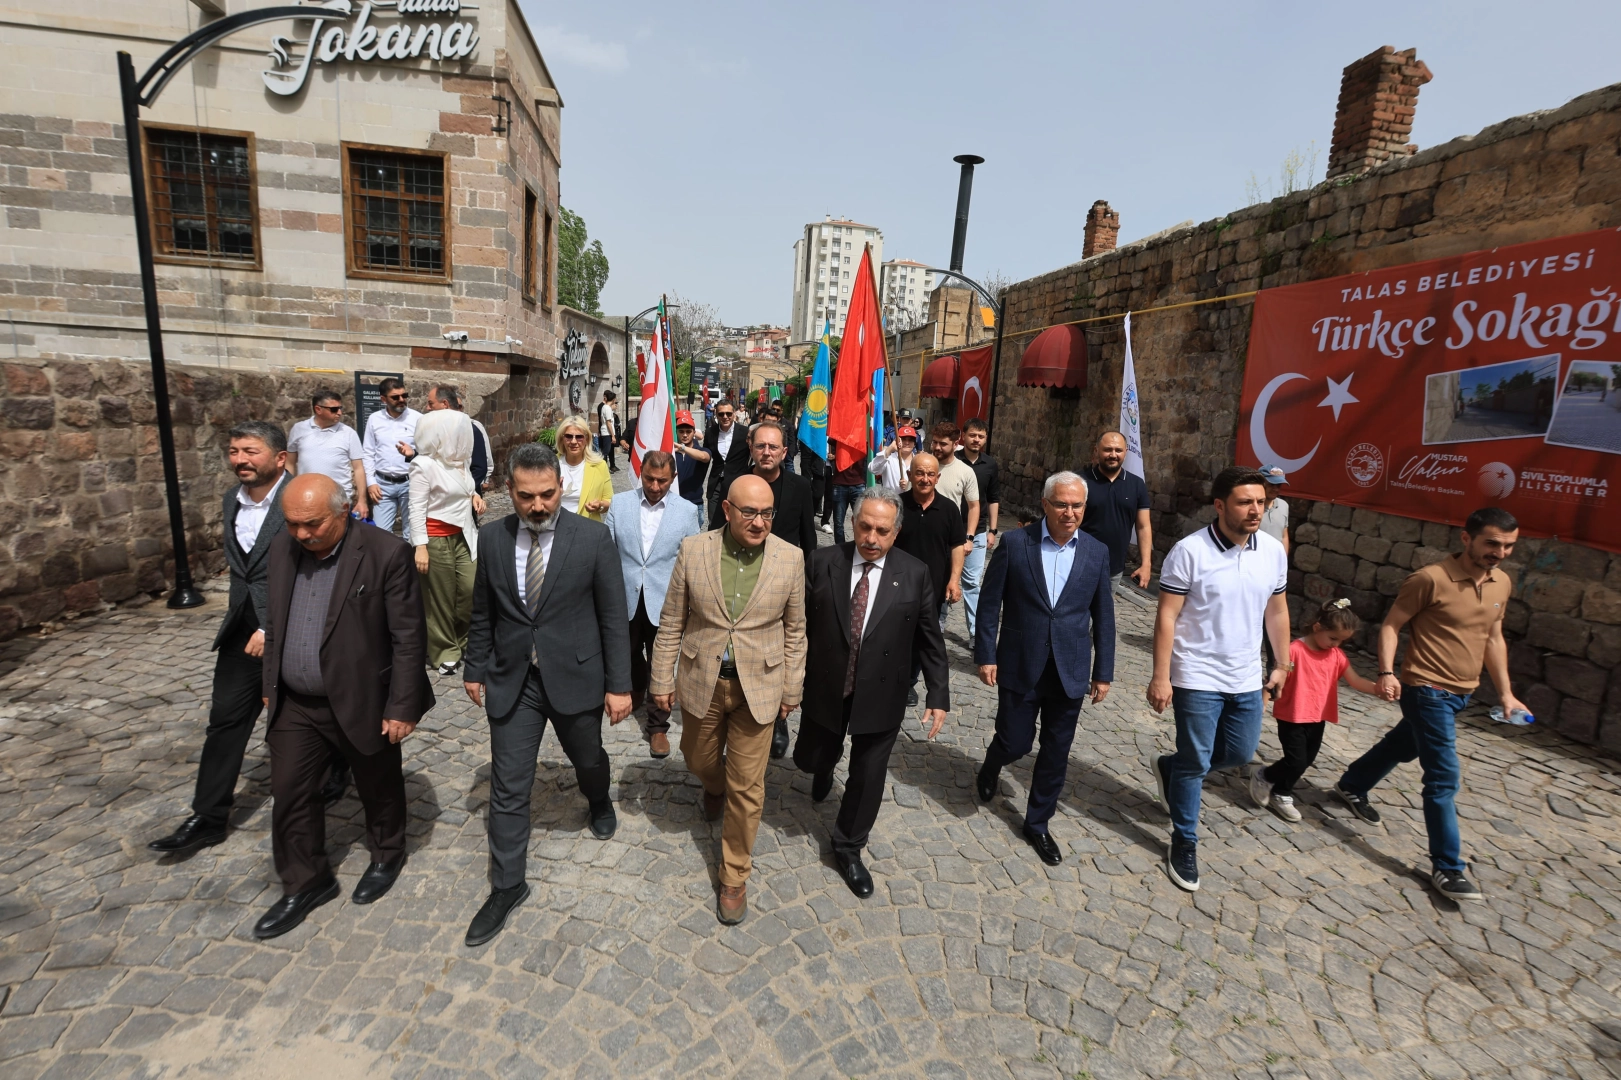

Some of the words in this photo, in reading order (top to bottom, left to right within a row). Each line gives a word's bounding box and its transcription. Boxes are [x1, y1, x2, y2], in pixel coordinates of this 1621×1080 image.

[261, 0, 480, 96] Tokana
[1341, 279, 1407, 303] TALAS
[1311, 309, 1437, 359] Türkçe
[1430, 453, 1469, 463] MUSTAFA
[1398, 453, 1466, 489] Yalçın
[1548, 473, 1609, 488] TOPLUMLA
[1390, 480, 1406, 488] Talas
[1407, 482, 1436, 493] Belediye
[1437, 486, 1465, 496] Başkanı
